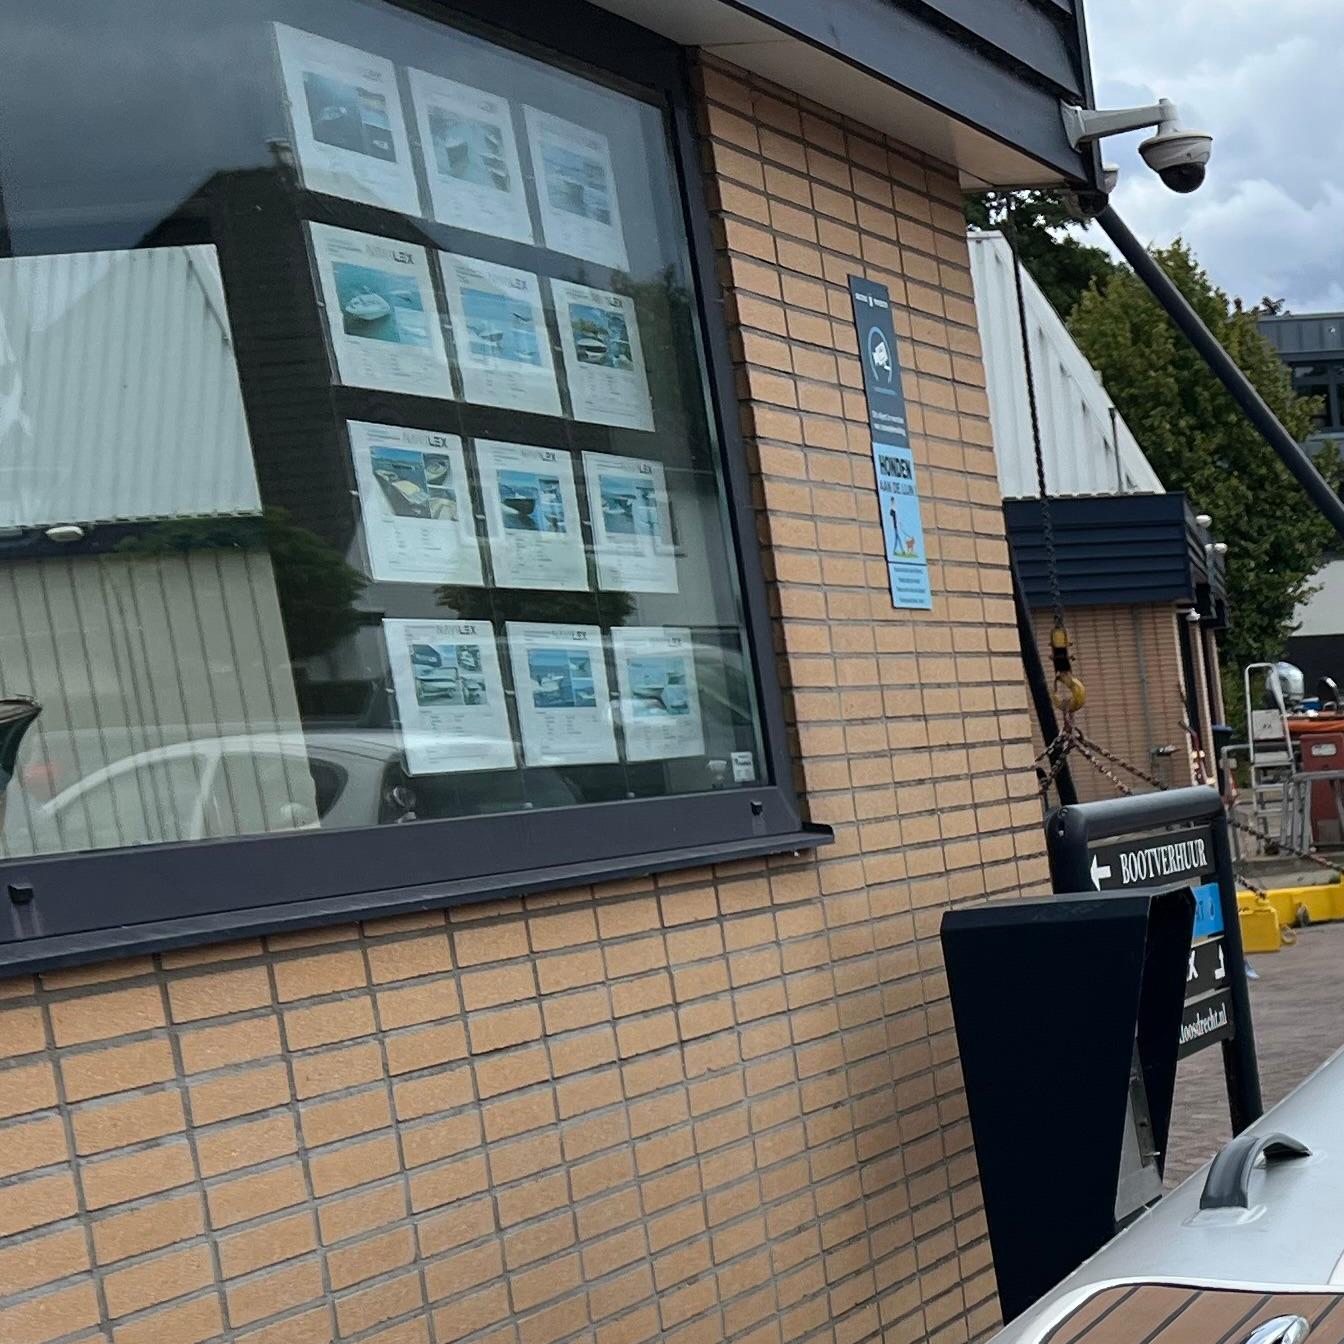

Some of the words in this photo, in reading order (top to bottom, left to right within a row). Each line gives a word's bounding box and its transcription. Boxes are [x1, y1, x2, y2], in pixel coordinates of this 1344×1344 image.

[878, 454, 913, 480] HONDEN
[1120, 838, 1208, 884] BOOTVERHUUR
[1179, 1002, 1228, 1044] loosdrecht.nl
